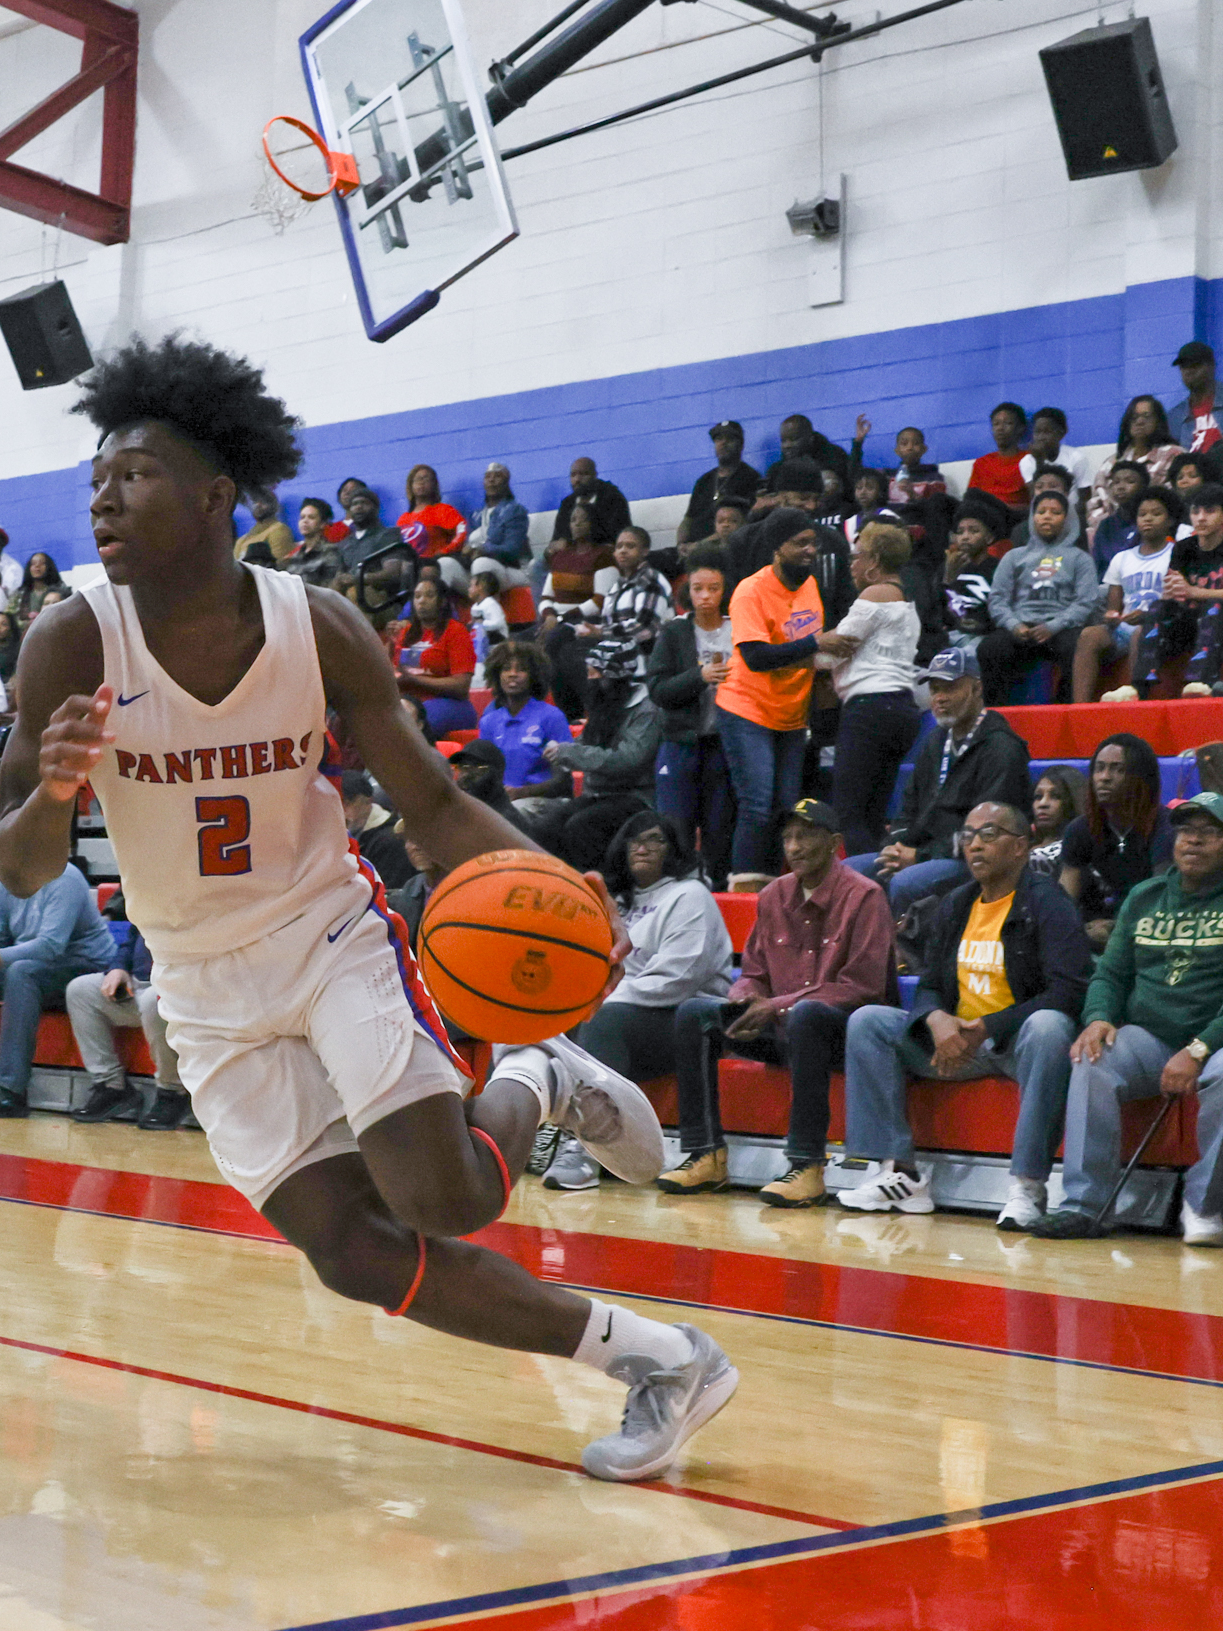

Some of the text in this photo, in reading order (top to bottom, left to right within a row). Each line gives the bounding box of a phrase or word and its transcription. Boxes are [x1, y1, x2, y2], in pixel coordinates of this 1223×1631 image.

[194, 795, 252, 876] 2
[503, 885, 578, 921] EVO
[968, 973, 991, 995] M
